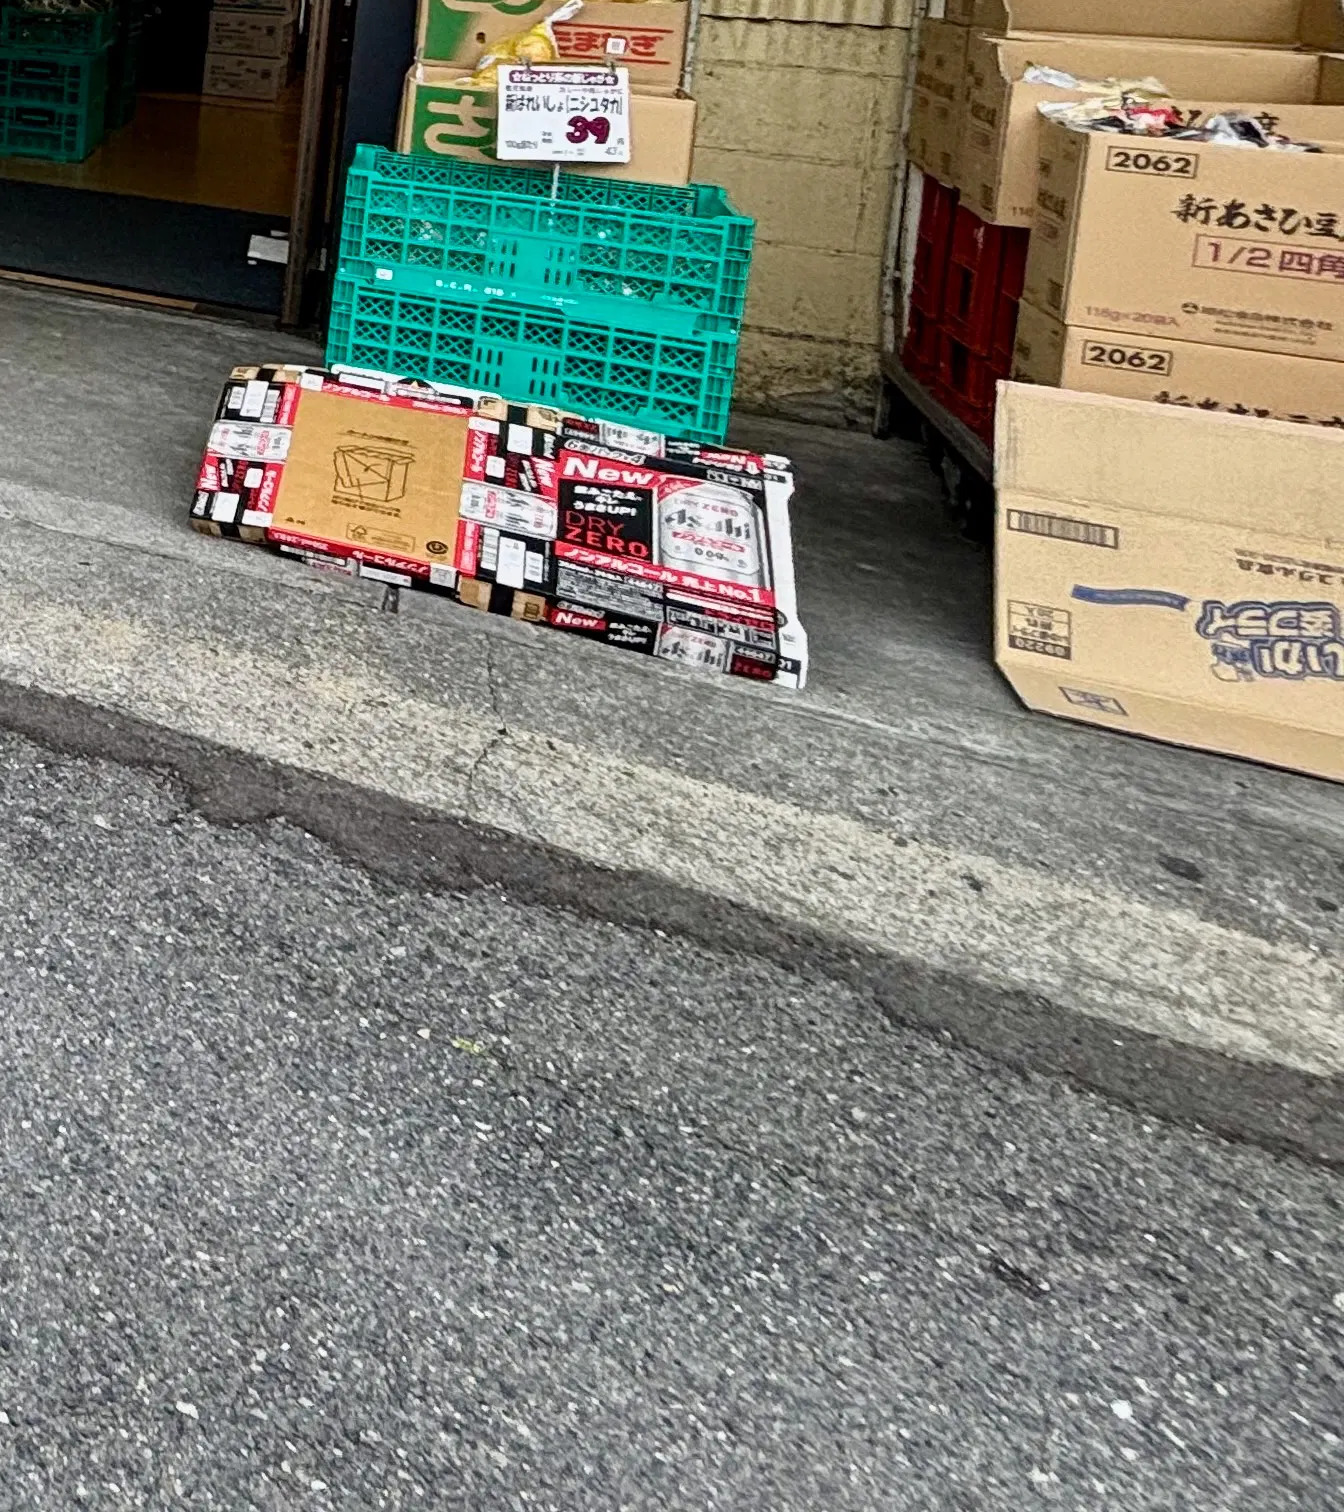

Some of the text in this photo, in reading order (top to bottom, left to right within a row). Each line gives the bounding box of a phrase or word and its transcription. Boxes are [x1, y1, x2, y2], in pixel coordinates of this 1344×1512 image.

[565, 115, 611, 145] 39
[1112, 151, 1192, 174] 2062
[1170, 193, 1344, 243] 新あさひ豆
[1088, 345, 1167, 372] 2062
[563, 456, 654, 487] New
[565, 510, 625, 533] DRY
[664, 508, 751, 540] Asahi
[565, 525, 650, 559] ZERO
[563, 548, 677, 584] ノンアルコール
[554, 611, 600, 628] New
